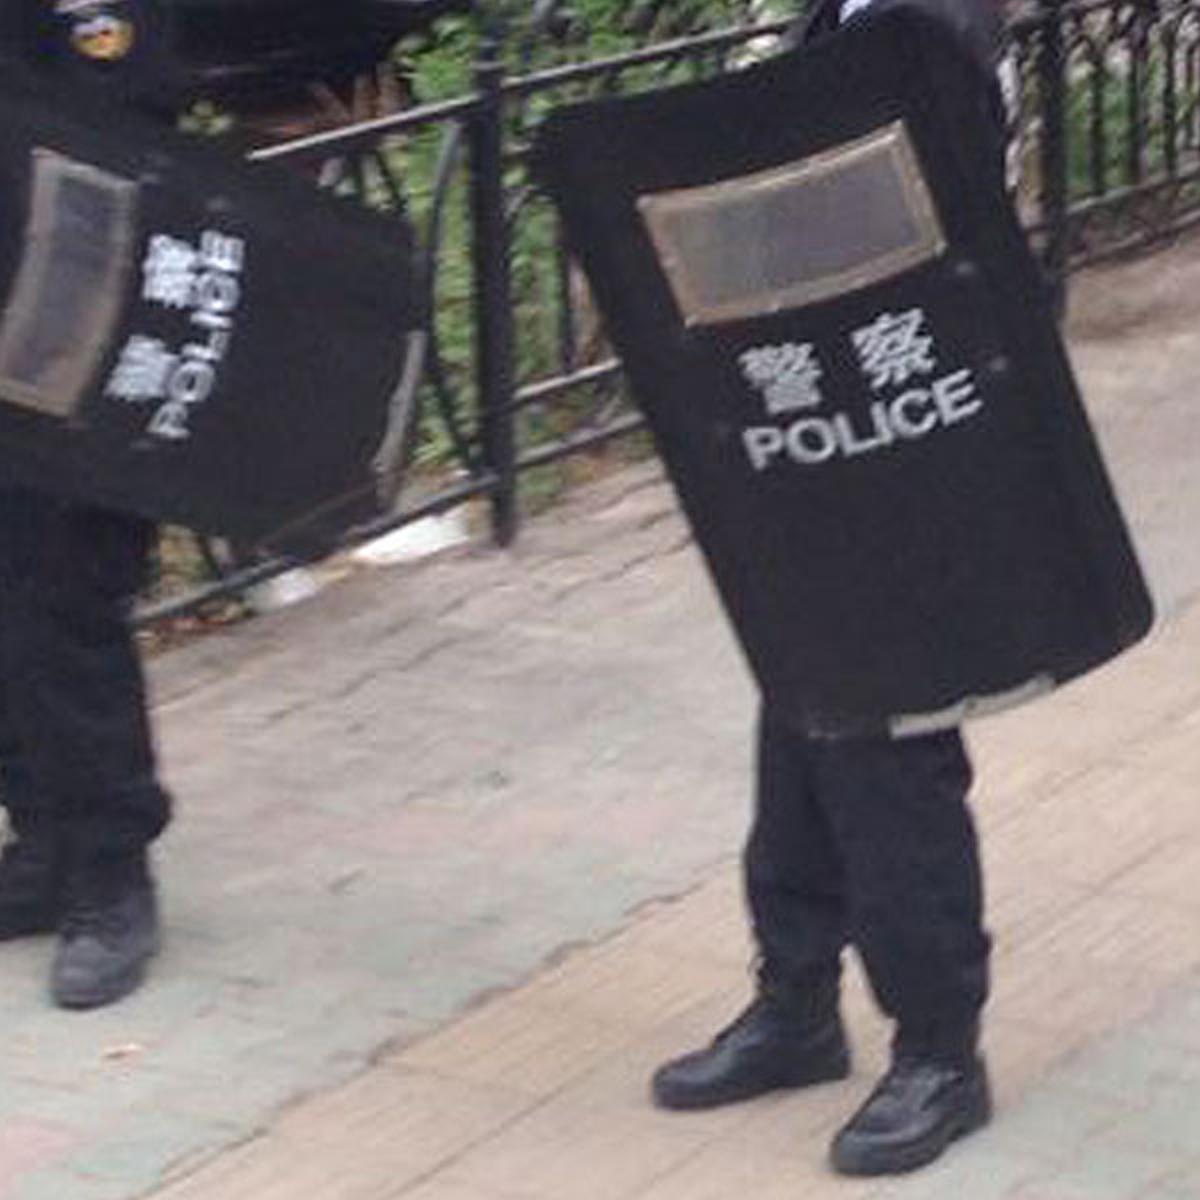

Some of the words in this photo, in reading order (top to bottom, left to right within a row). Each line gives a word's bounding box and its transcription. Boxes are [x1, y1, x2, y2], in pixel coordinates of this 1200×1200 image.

[103, 233, 199, 404] 警察
[147, 230, 245, 438] POLICE
[738, 307, 938, 415] 警察
[743, 368, 983, 470] POLICE
